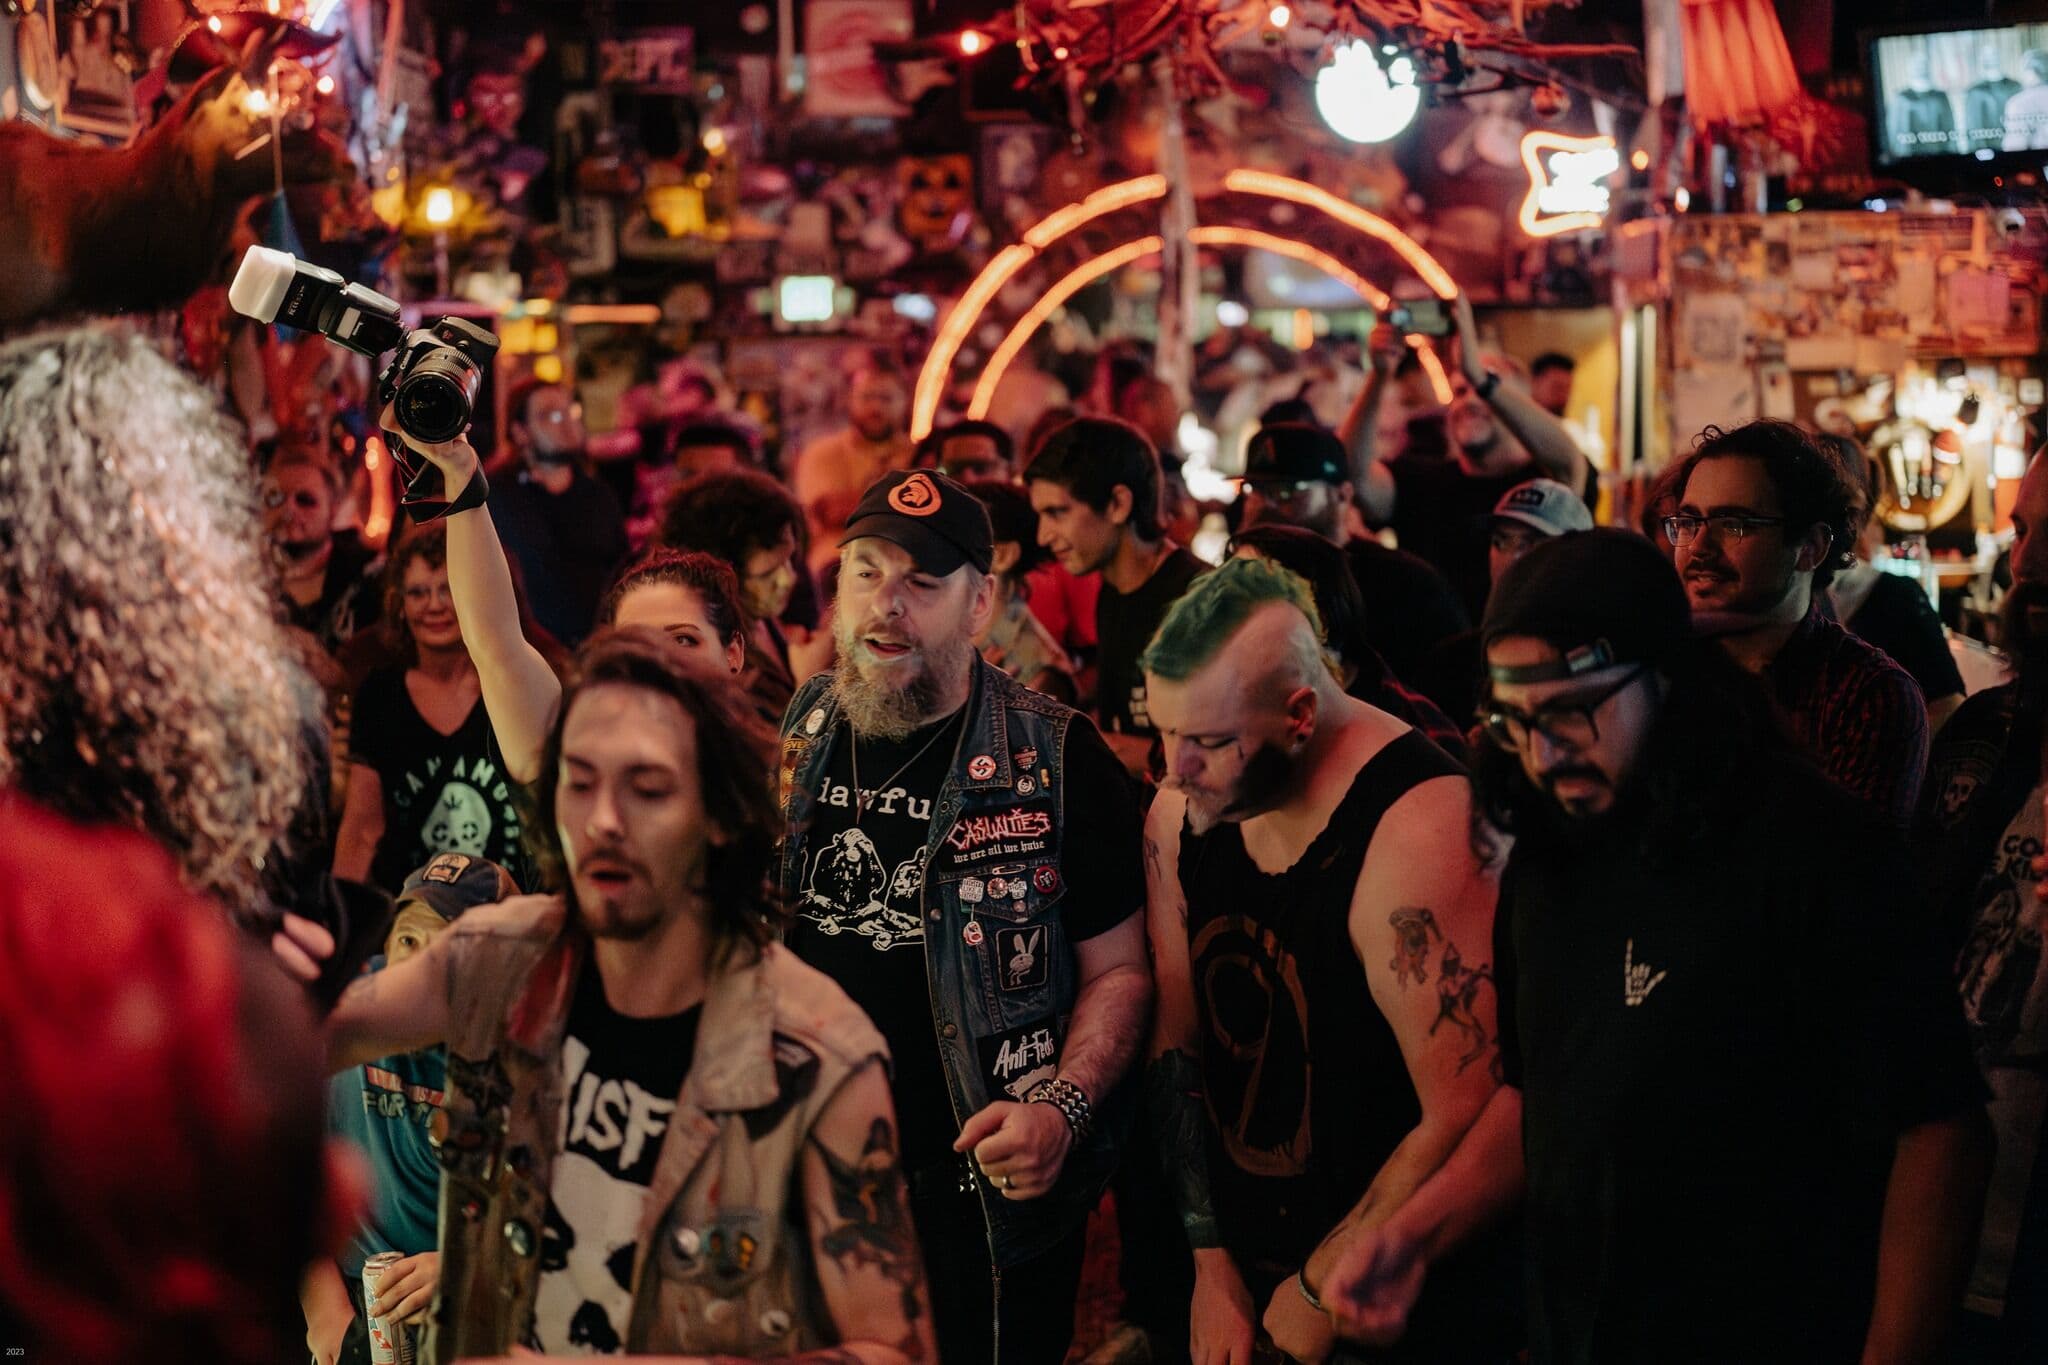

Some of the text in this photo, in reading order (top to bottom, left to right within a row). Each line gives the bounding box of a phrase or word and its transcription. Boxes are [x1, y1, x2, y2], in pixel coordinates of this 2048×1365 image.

[946, 807, 1051, 850] CASUALTIES
[953, 840, 1046, 863] we are all we have
